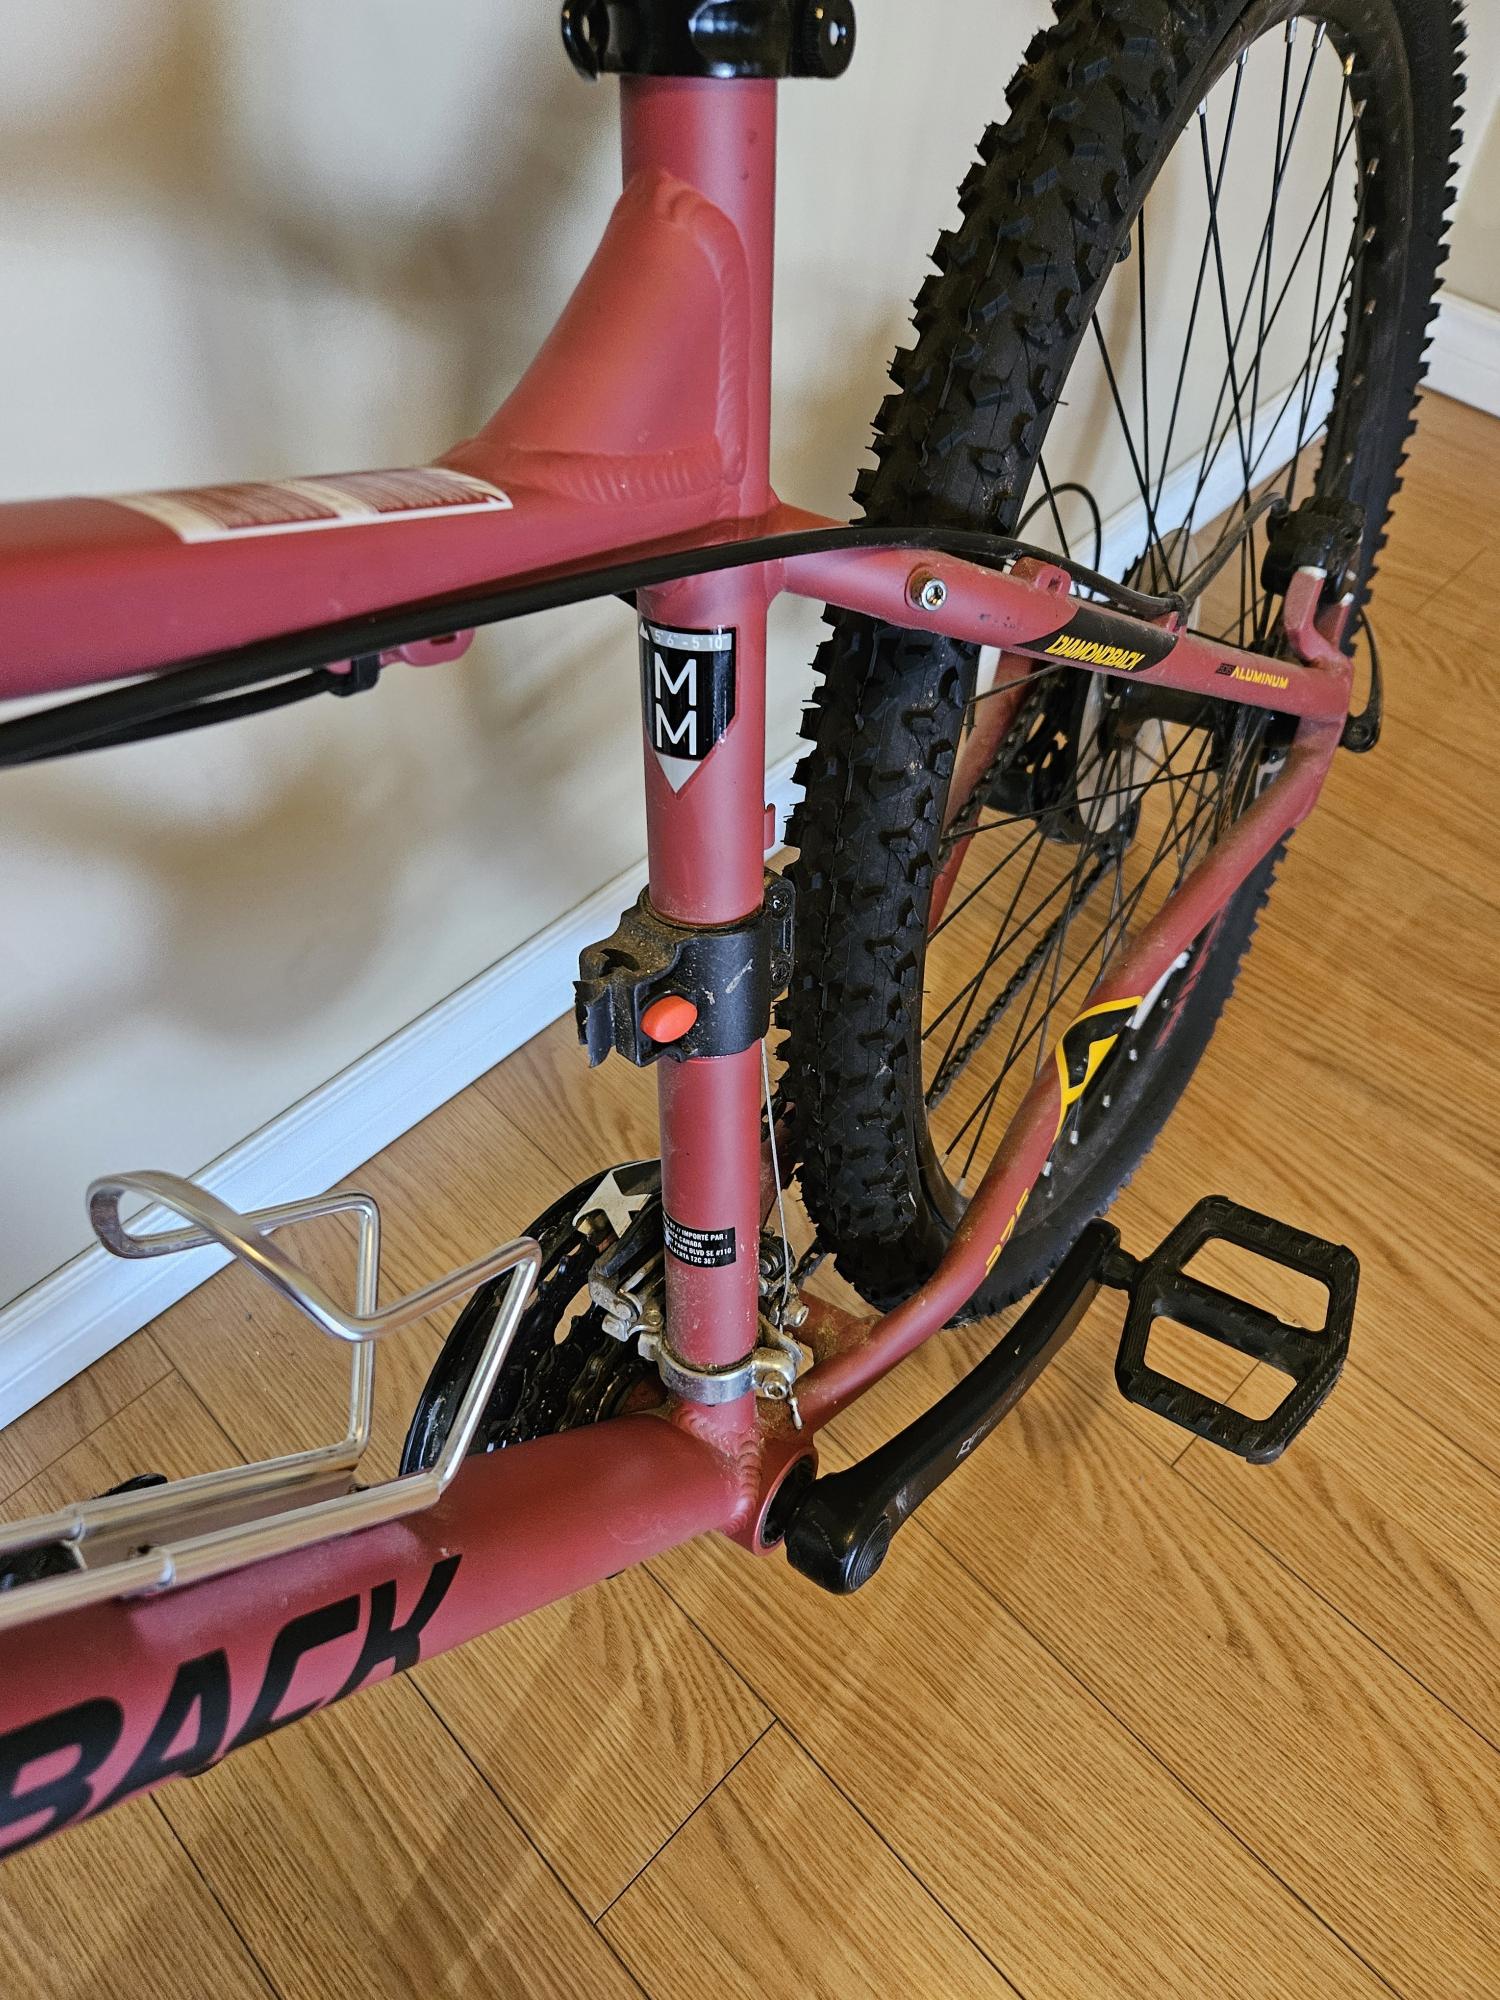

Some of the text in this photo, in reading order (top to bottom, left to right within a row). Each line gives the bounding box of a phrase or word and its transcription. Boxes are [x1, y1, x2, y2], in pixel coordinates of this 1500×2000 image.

[1043, 634, 1146, 670] DIAMONDBACK
[1230, 665, 1289, 690] ALUMINUM
[678, 1236, 702, 1248] CANADA
[682, 1230, 709, 1241] IMPORTÉ
[710, 1233, 724, 1241] PAR
[674, 1241, 688, 1252] PARK
[688, 1247, 705, 1256] BLVD
[716, 1248, 732, 1256] #110
[0, 1554, 463, 1860] BACK
